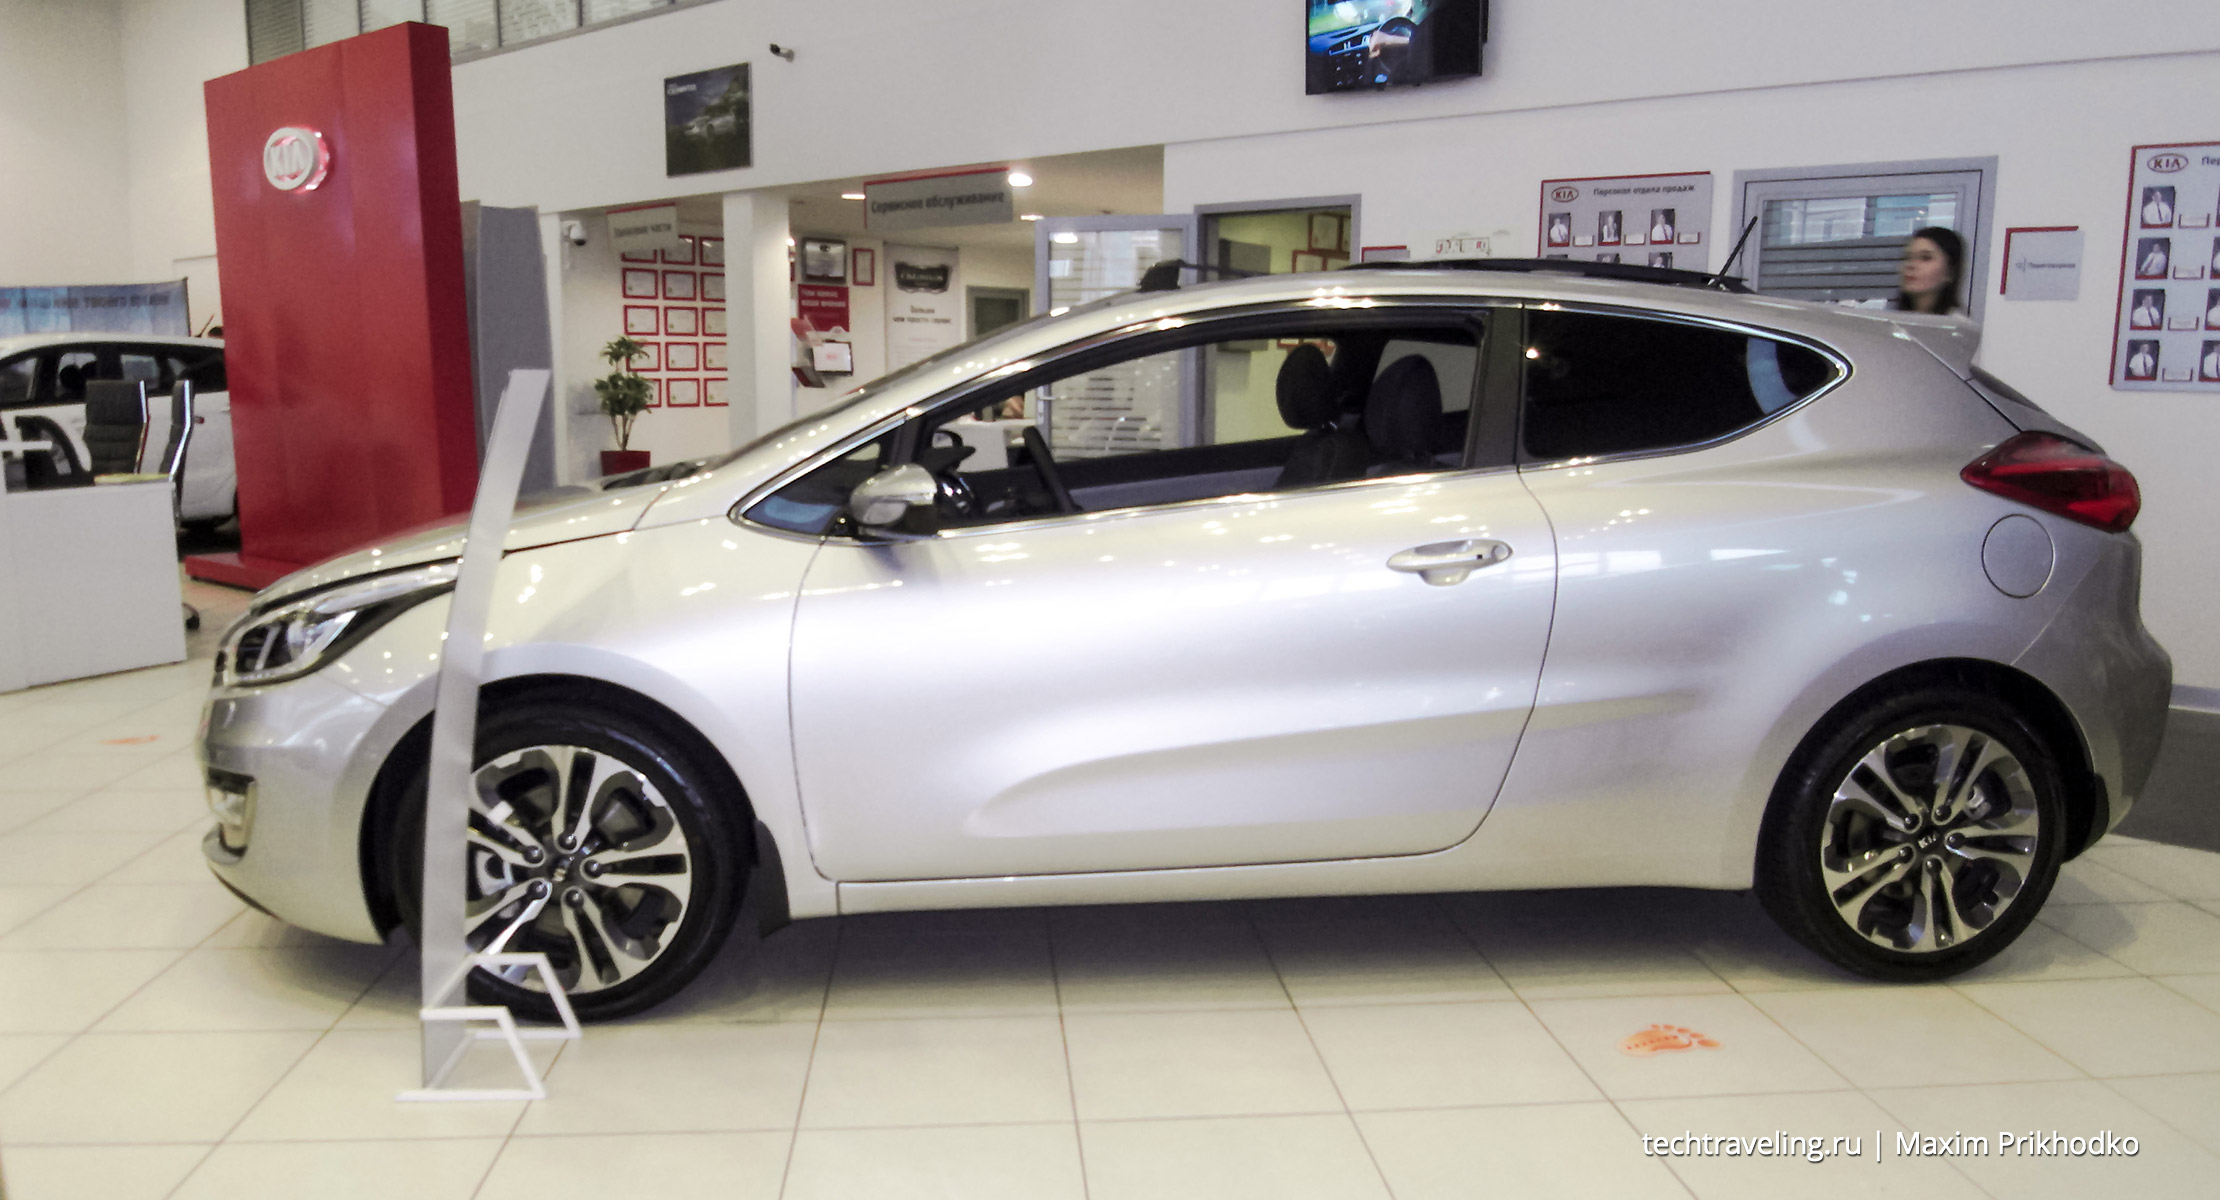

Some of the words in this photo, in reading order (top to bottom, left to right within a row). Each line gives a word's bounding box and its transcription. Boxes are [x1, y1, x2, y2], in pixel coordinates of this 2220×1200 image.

[269, 140, 310, 177] KIA
[1593, 188, 1631, 197] Персонал
[1633, 187, 1661, 195] отдела
[1662, 185, 1695, 193] продаж
